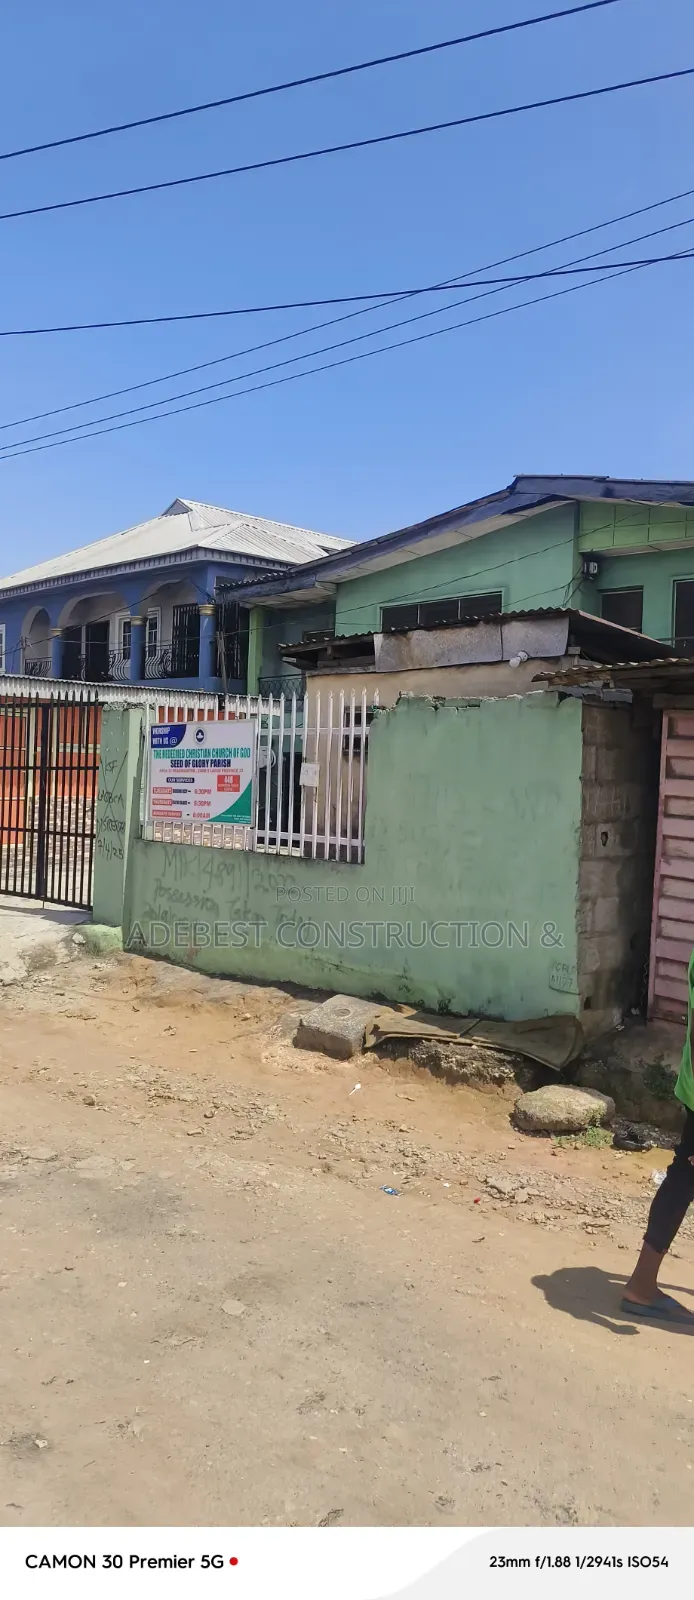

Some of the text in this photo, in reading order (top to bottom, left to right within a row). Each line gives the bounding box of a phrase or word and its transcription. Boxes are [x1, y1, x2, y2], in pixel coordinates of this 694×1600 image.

[152, 727, 170, 735] WORSHIP
[152, 736, 178, 745] WITH US @
[153, 748, 251, 759] THE REDEEMED CHRISTIAN CHURCH OF GOD
[170, 759, 231, 768] SEED OF GLORY PARISH
